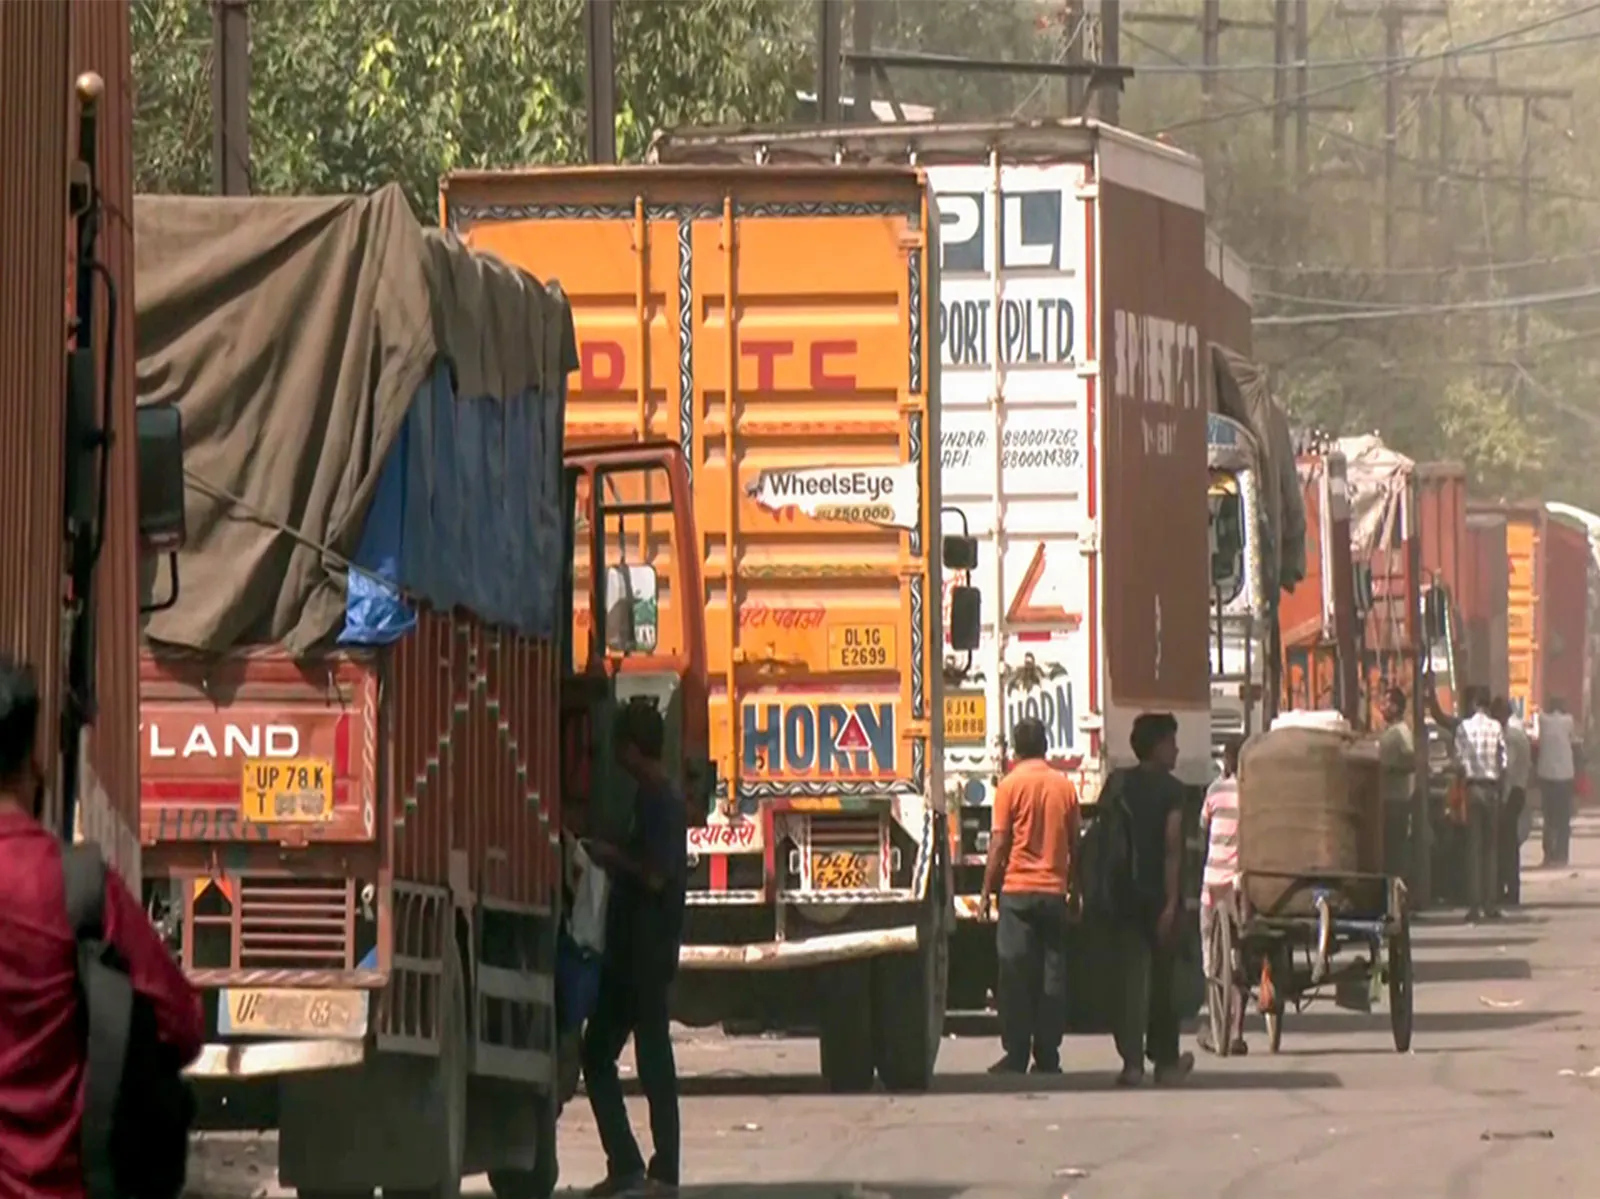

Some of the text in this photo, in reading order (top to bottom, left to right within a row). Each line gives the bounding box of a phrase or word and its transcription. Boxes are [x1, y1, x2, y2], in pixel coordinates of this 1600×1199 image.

[769, 472, 893, 501] WheelsEye
[841, 647, 886, 665] E2699
[139, 723, 299, 758] LAND
[743, 702, 895, 776] HORN
[256, 766, 324, 789] UP 78 K
